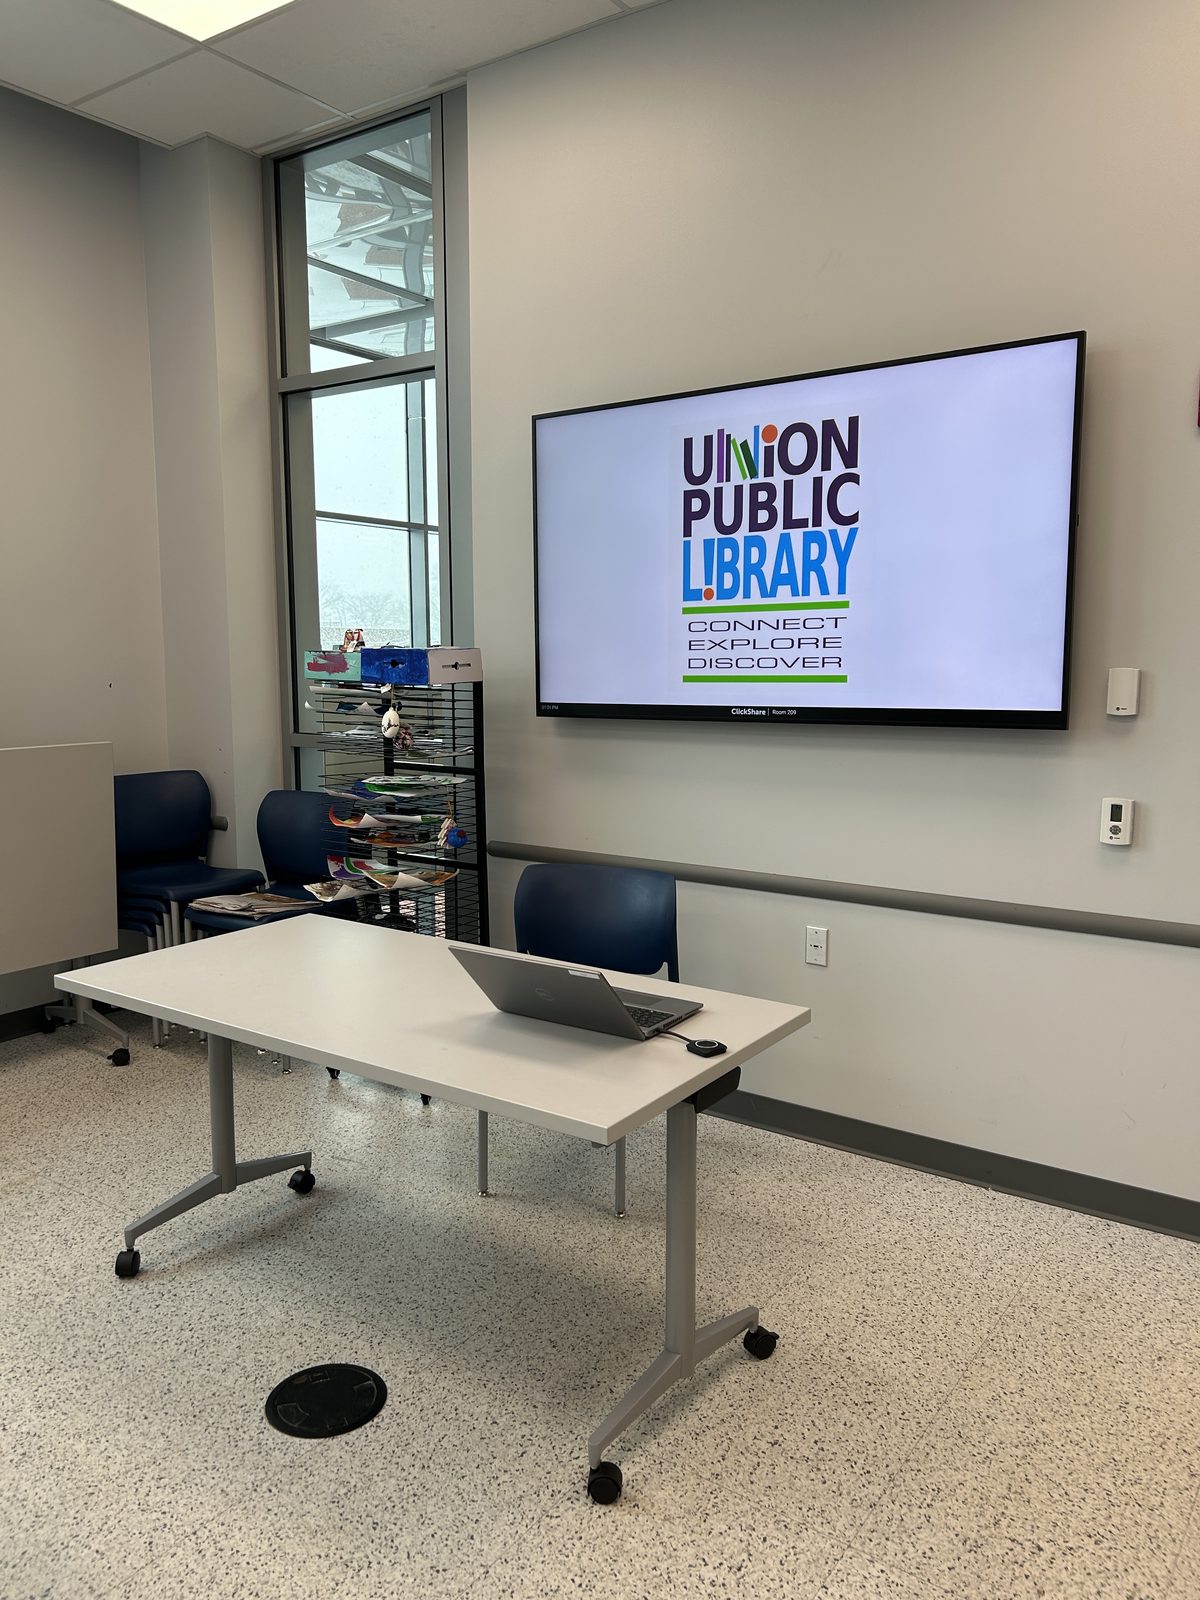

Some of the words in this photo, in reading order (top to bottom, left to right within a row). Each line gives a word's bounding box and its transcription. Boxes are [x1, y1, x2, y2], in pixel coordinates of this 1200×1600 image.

[683, 472, 860, 537] PUBLIC
[688, 617, 847, 633] CONNECT
[688, 637, 842, 650] EXPLORE
[688, 657, 842, 669] DISCOVER
[731, 708, 766, 716] ClickShare
